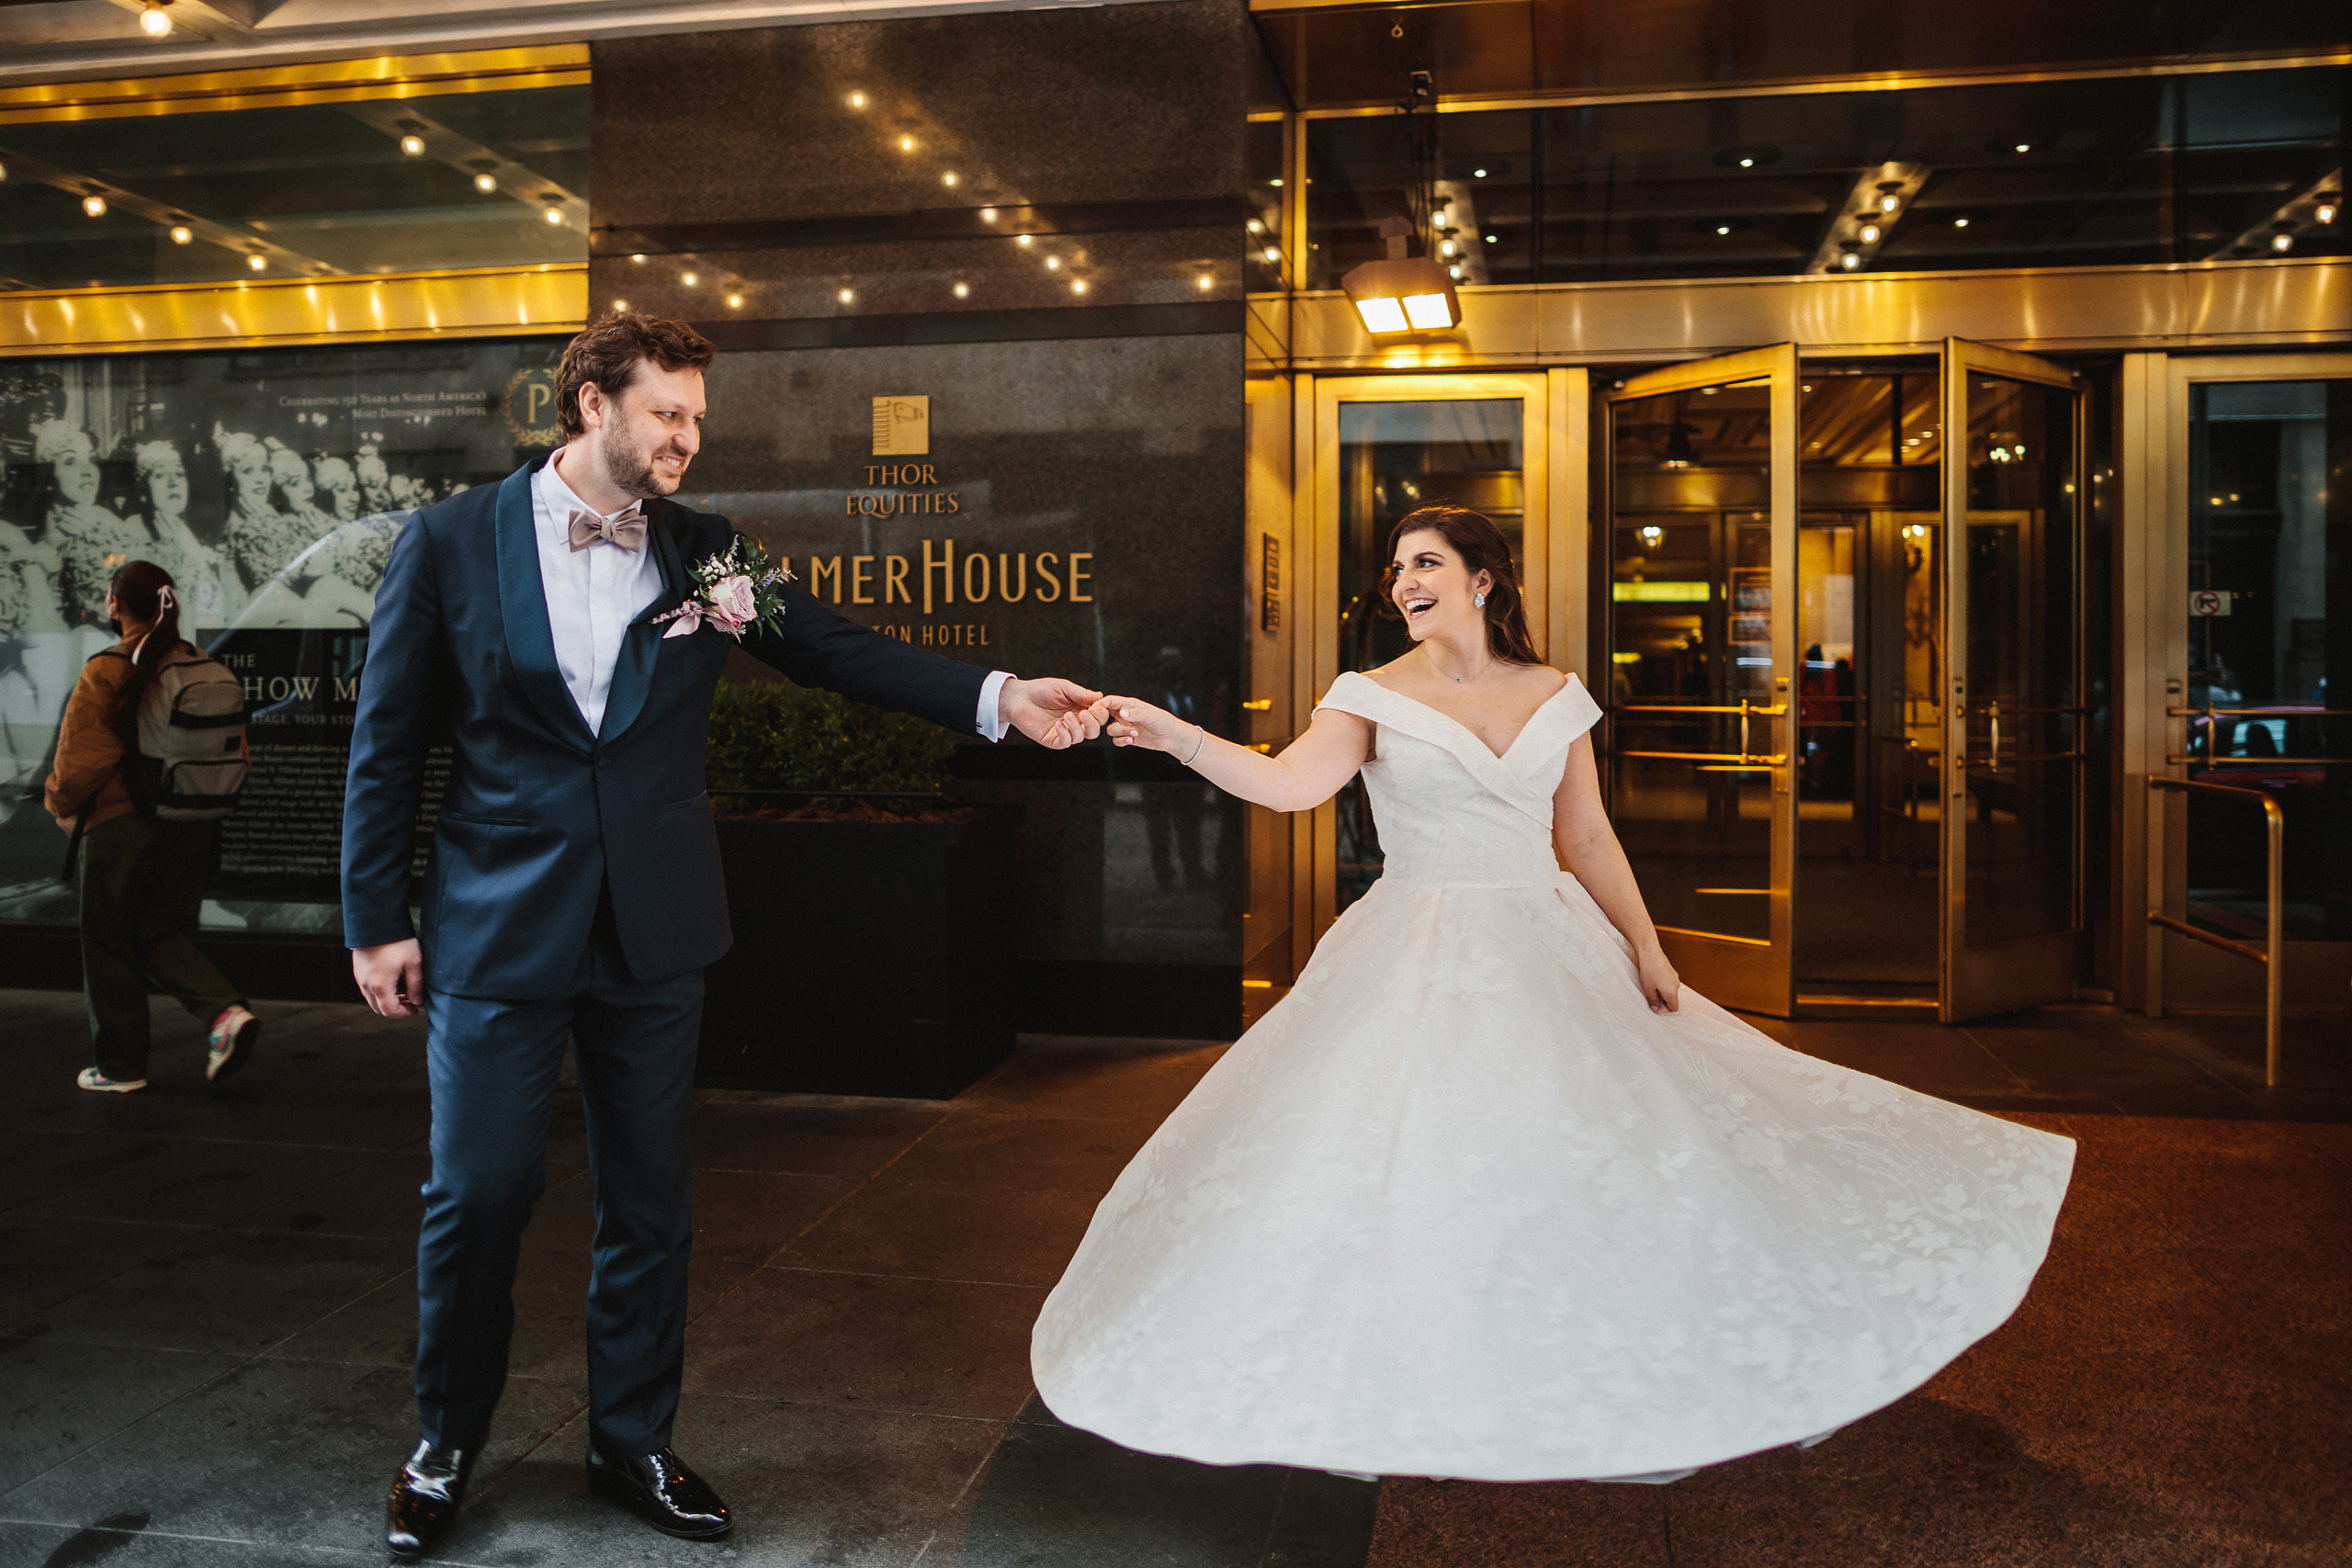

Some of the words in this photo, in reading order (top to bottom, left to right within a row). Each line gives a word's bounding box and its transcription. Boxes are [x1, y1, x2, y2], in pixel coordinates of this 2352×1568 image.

[864, 464, 940, 485] THOR
[846, 492, 959, 519] EQUITIES
[922, 625, 989, 646] HOTEL
[222, 654, 256, 668] THE
[243, 676, 320, 702] HOW
[333, 676, 357, 702] M
[294, 715, 326, 726] YOUR
[331, 715, 355, 726] STO
